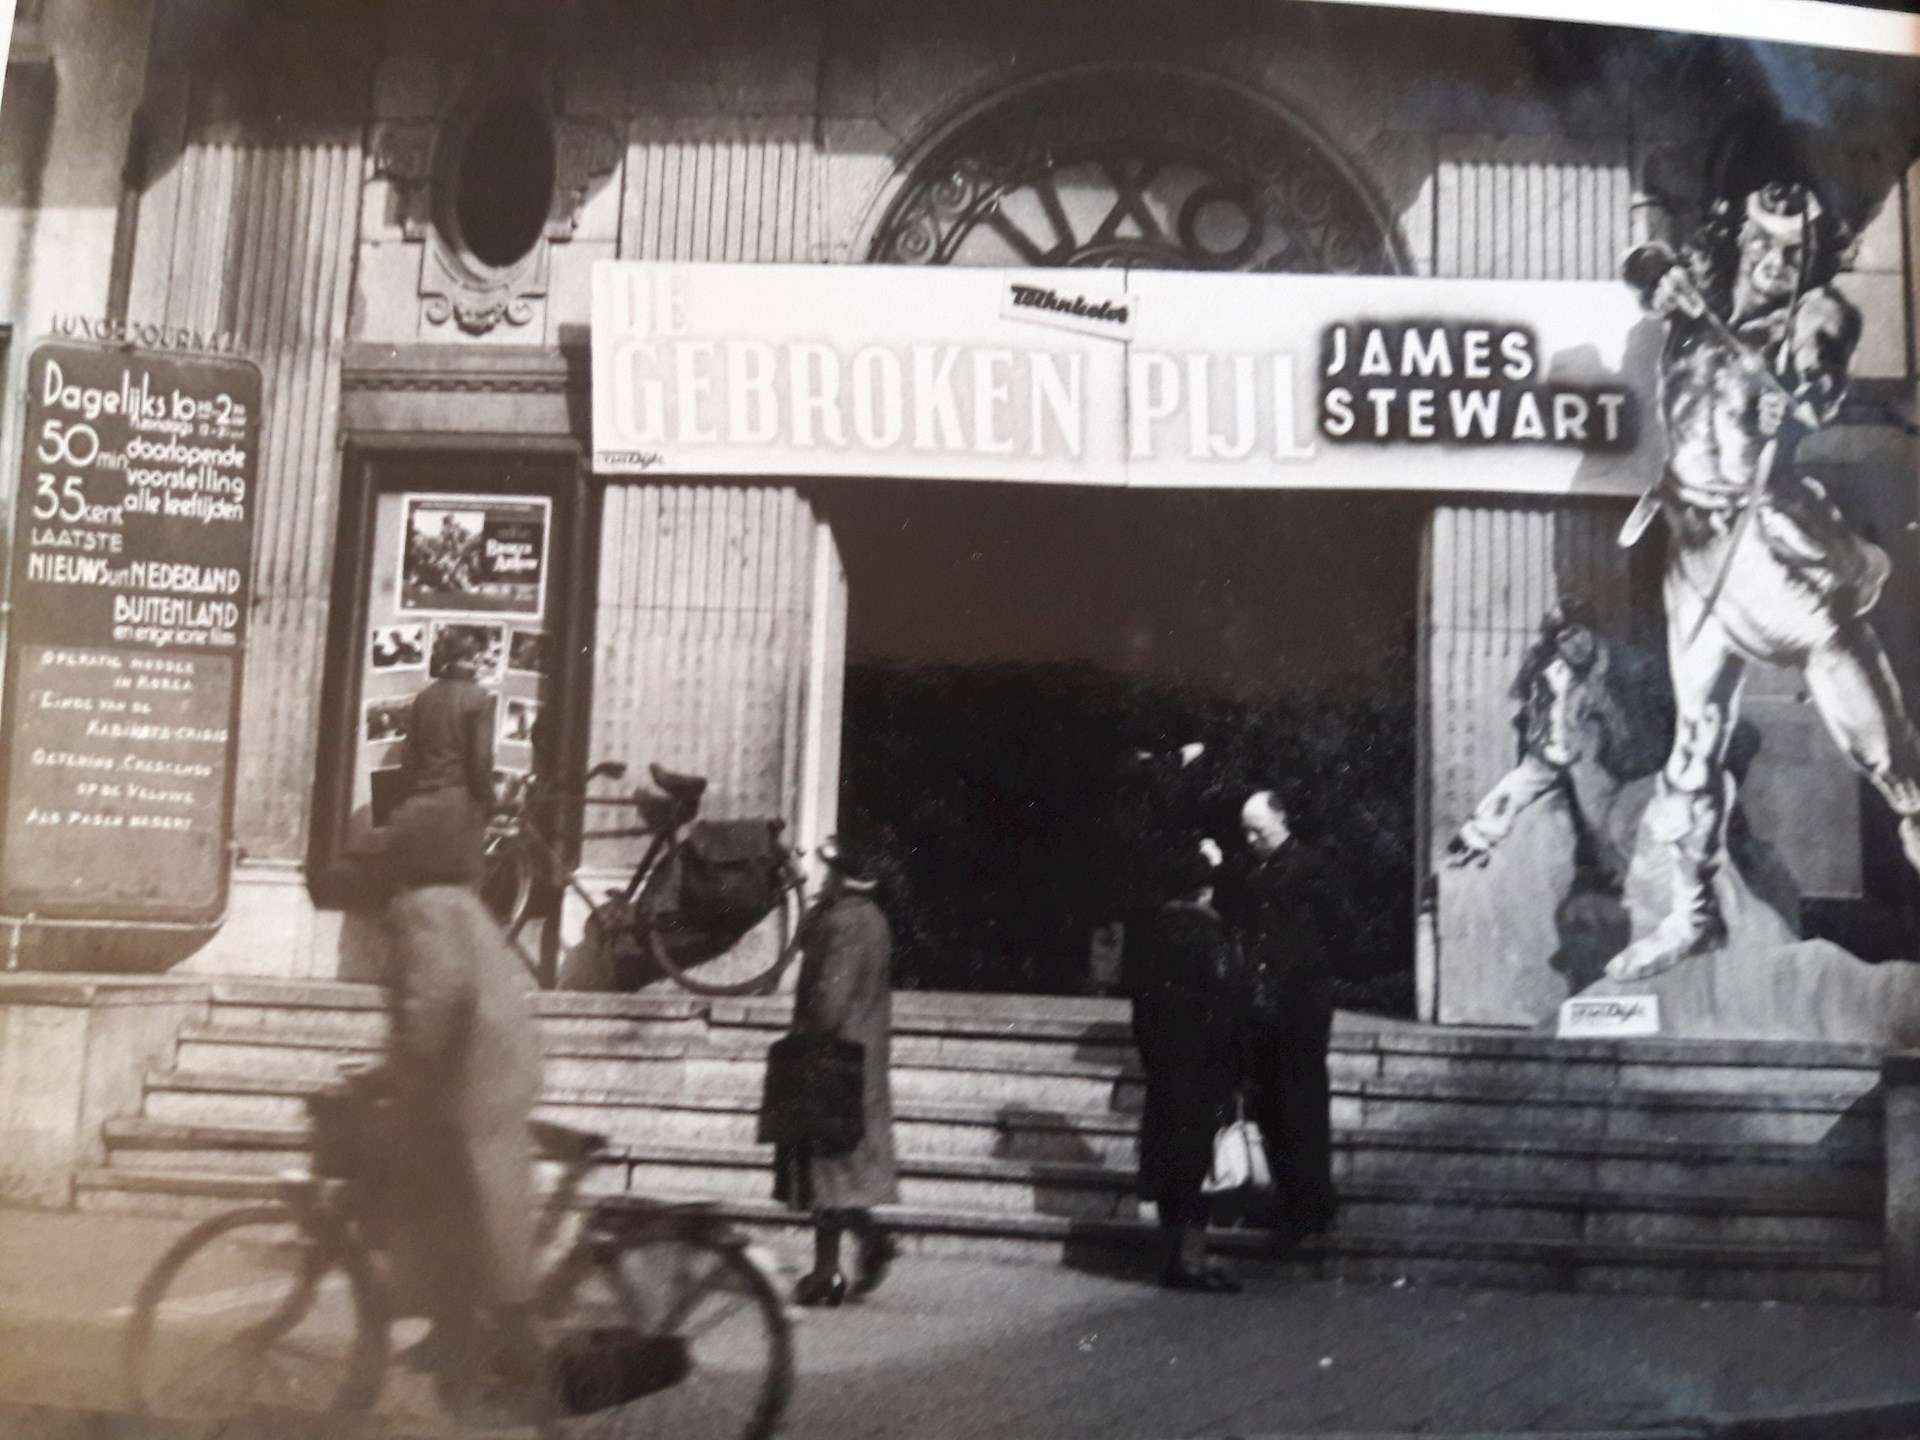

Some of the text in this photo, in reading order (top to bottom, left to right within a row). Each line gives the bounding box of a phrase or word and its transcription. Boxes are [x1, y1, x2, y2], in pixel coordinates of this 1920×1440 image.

[609, 268, 690, 337] DE
[1326, 327, 1533, 380] JAMES
[43, 359, 166, 424] Dagelijks
[614, 338, 1316, 460] GEBROKEN PIJL
[1324, 387, 1626, 442] STEWART
[38, 419, 99, 467] 50
[127, 436, 246, 468] doorlopende
[34, 473, 87, 522] 35
[124, 491, 161, 514] alle
[127, 465, 246, 503] voorstelling
[32, 527, 123, 552] LAATSTE
[28, 552, 109, 584] NIEUWS
[131, 560, 241, 595] NEDERLAND
[114, 594, 239, 628] BUITENLAND
